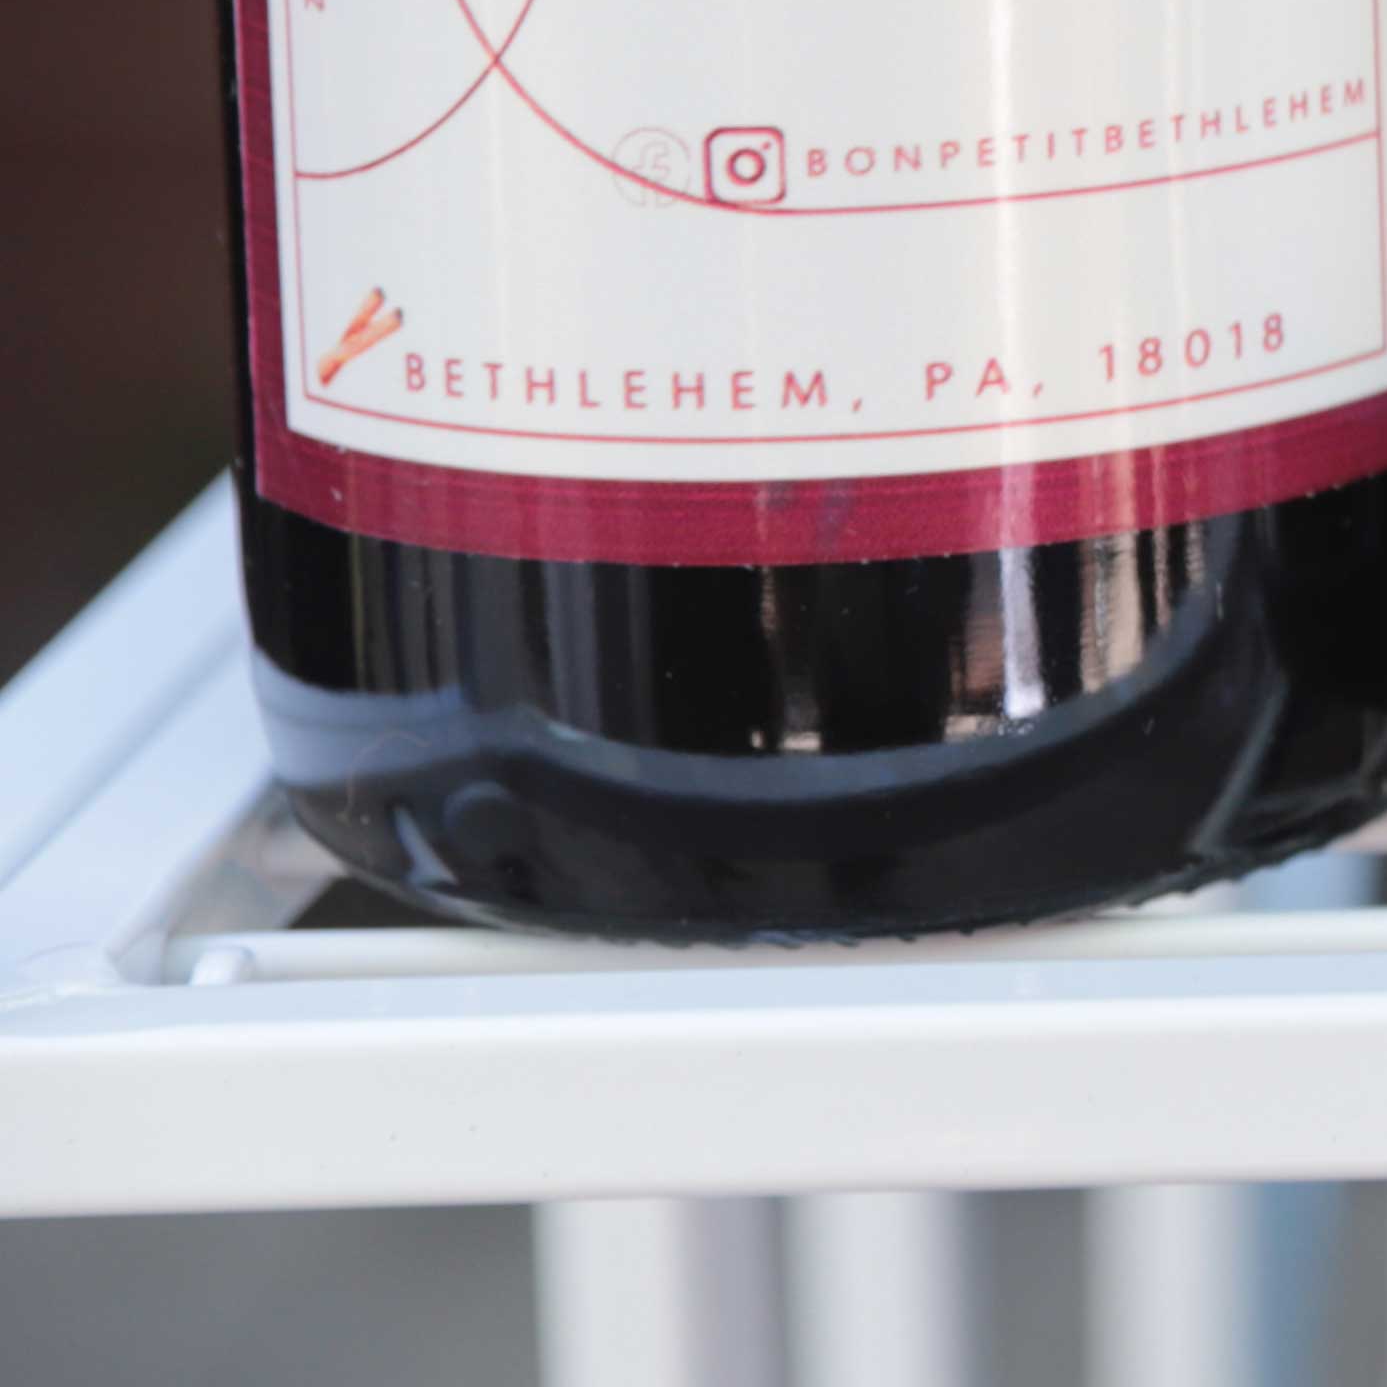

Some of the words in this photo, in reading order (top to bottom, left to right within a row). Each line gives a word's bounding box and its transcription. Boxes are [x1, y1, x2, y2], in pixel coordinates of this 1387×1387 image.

[807, 79, 1367, 178] BONPETITBETHLEHEM
[405, 352, 863, 413] BETHLEHEM,
[925, 358, 1046, 403] PA,
[1100, 312, 1284, 382] 18018
